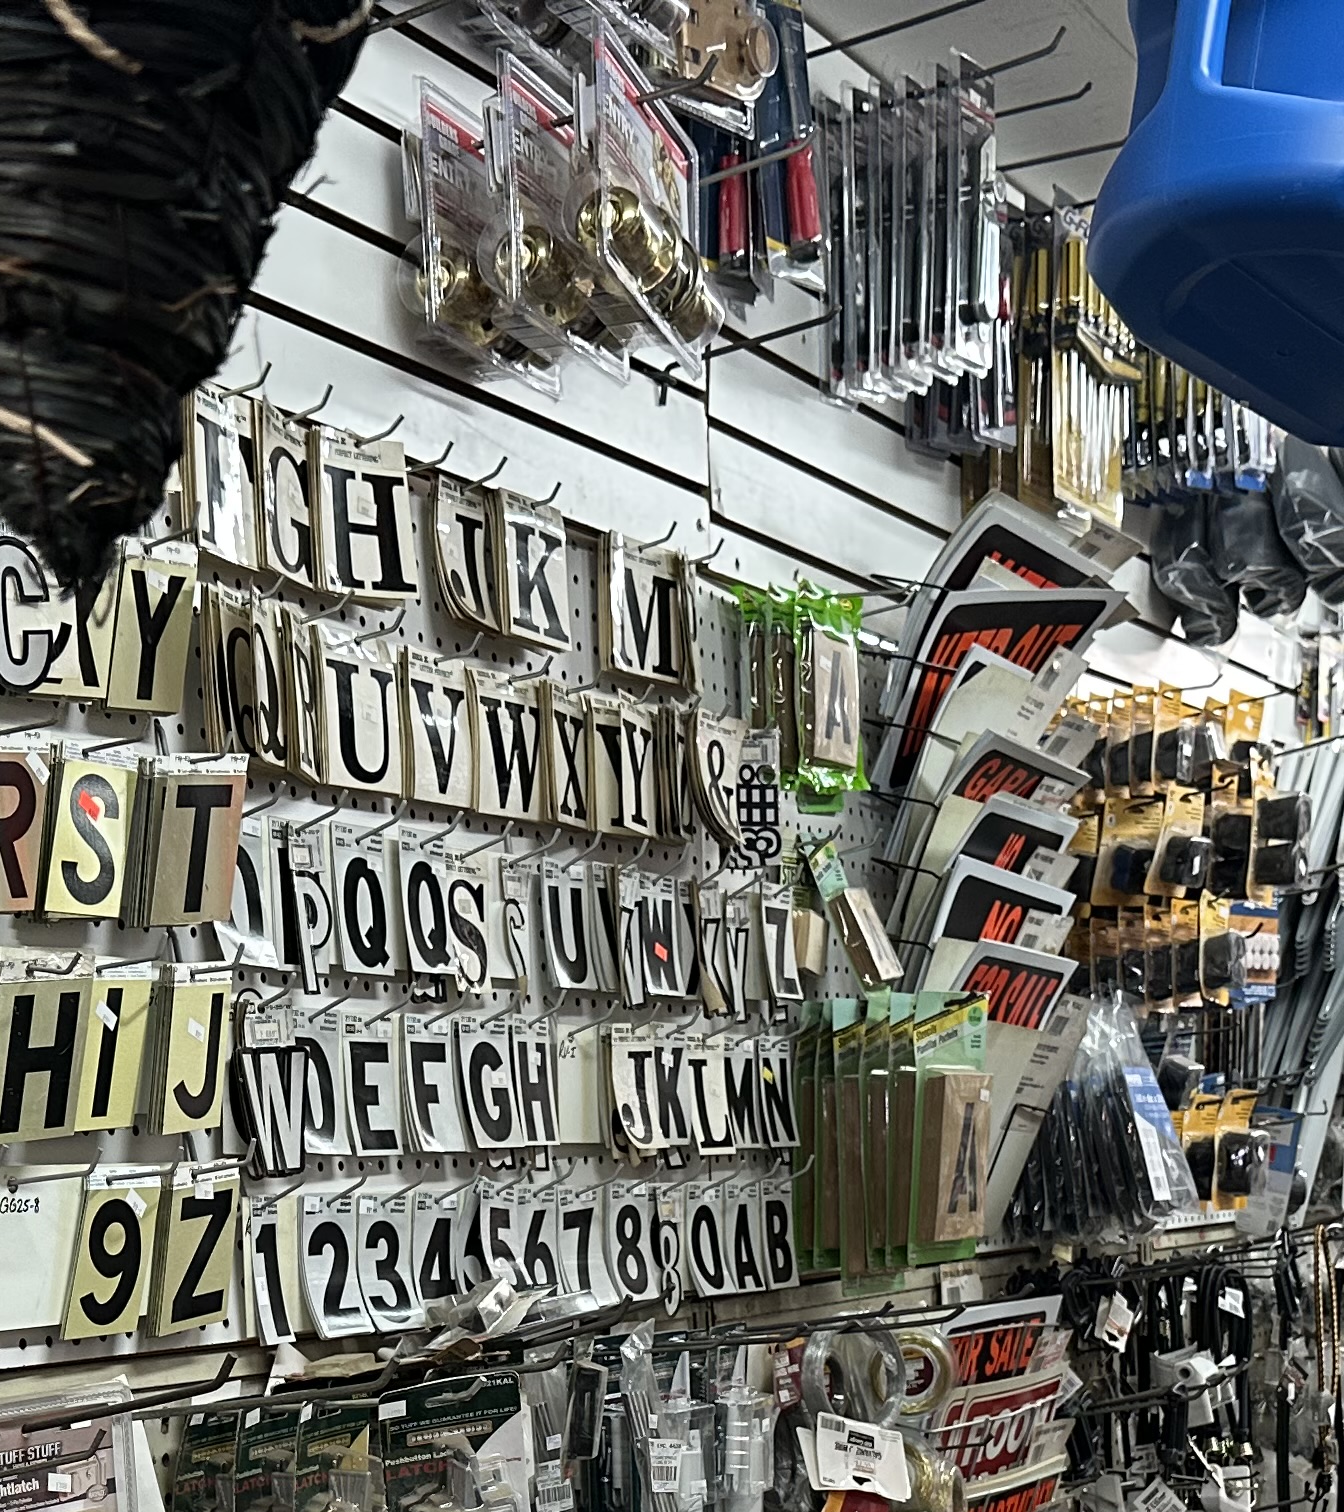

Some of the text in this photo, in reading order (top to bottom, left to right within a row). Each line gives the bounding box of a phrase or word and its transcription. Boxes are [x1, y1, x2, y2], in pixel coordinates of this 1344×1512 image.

[324, 465, 419, 592] H
[130, 570, 186, 702] Y
[514, 526, 570, 644] K
[618, 569, 680, 678] M
[327, 659, 397, 784] U
[410, 682, 467, 796] V
[480, 700, 544, 812] W
[555, 717, 588, 822] X
[620, 720, 654, 831] Y
[62, 773, 122, 906] S
[705, 740, 742, 845] &
[174, 785, 232, 913] T
[343, 857, 390, 969] Q
[449, 880, 487, 990] S
[981, 900, 1022, 942] NO
[0, 993, 78, 1134] H
[92, 988, 123, 1117] I
[173, 993, 224, 1121] J
[350, 1041, 399, 1152] E
[412, 1042, 446, 1145] F
[470, 1041, 511, 1142] G
[690, 1059, 730, 1147] L
[762, 1051, 795, 1142] N
[241, 1047, 309, 1176] W
[79, 1199, 142, 1327] 9
[171, 1188, 232, 1323] Z
[256, 1223, 293, 1338] 1
[307, 1220, 360, 1330] 2
[365, 1220, 409, 1322] 3
[419, 1217, 456, 1298] 4
[563, 1208, 595, 1292] 7
[618, 1205, 649, 1294] 8
[734, 1204, 764, 1289] A
[766, 1201, 794, 1284] B
[27, 1441, 62, 1460] STUFF
